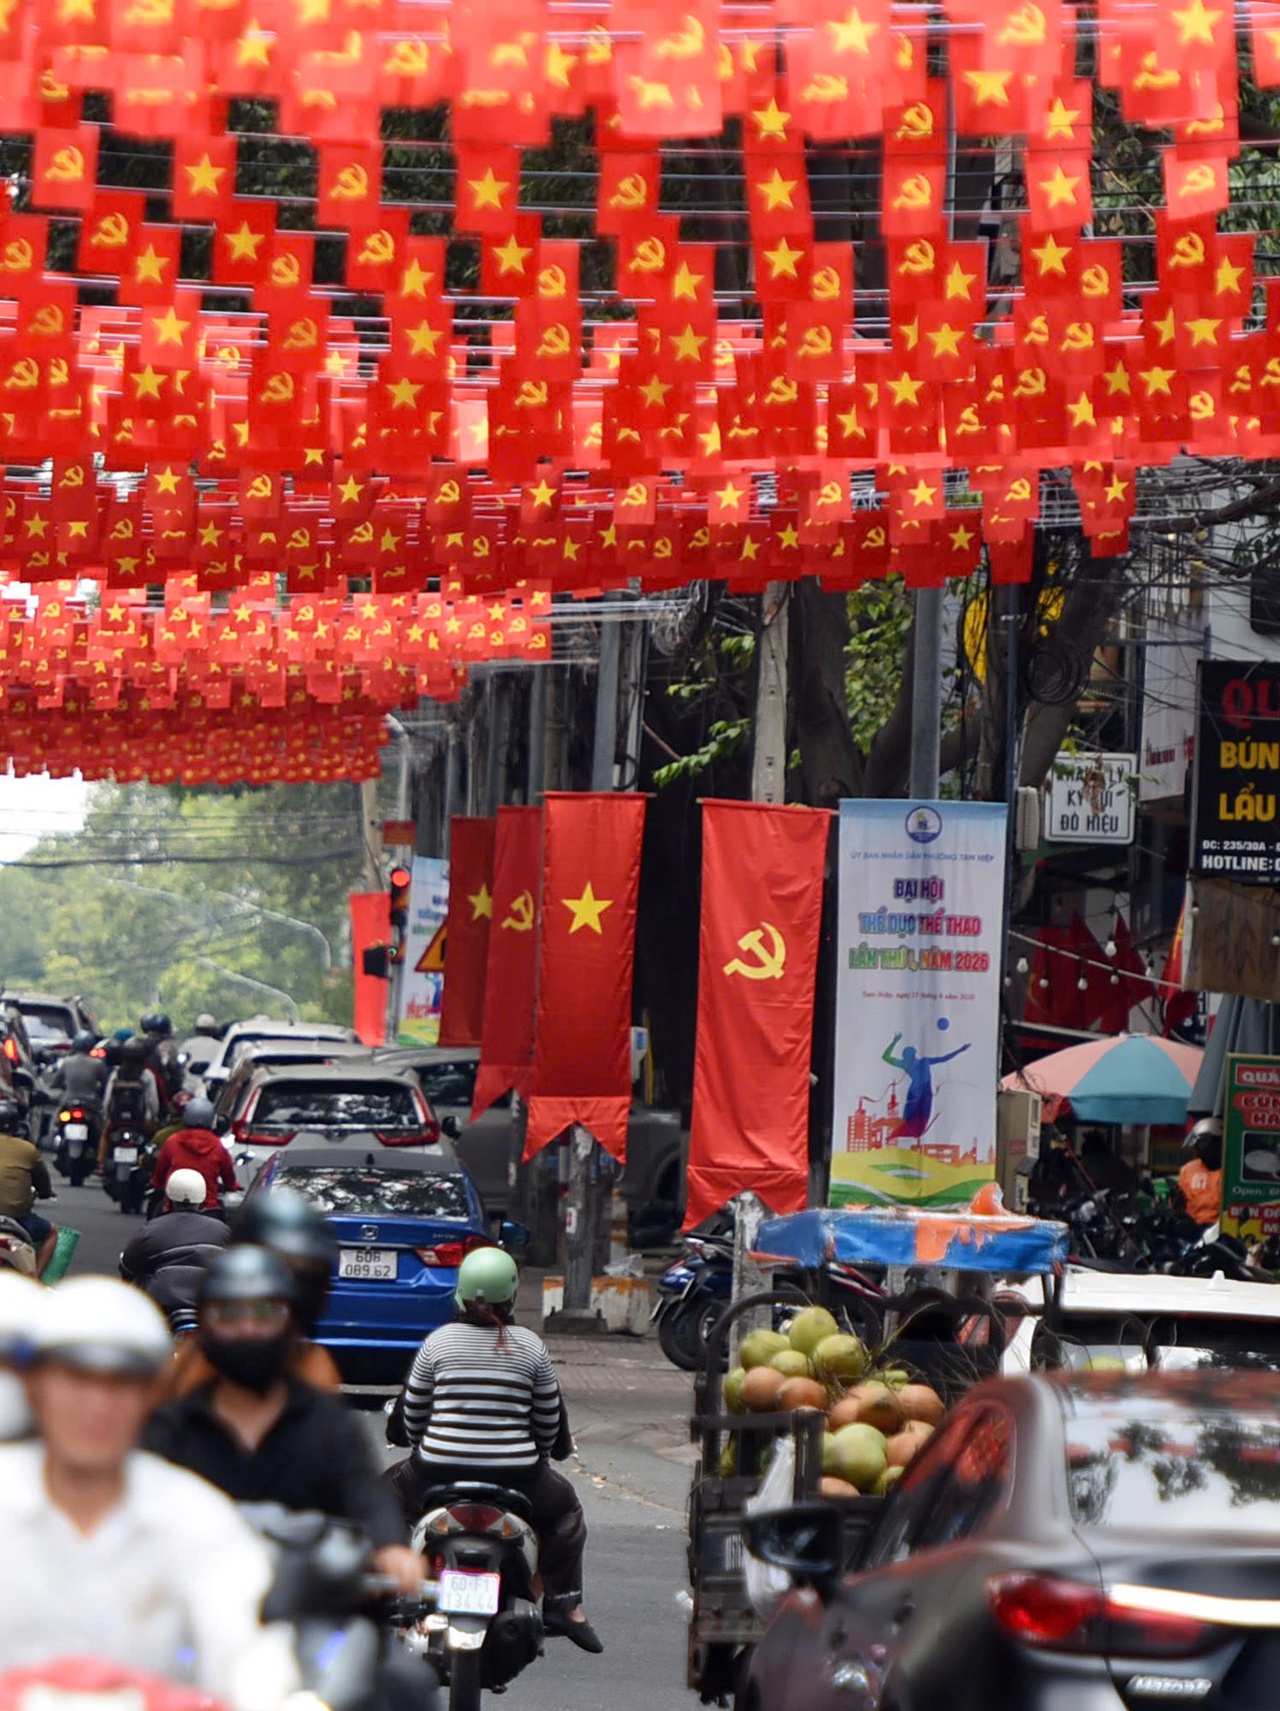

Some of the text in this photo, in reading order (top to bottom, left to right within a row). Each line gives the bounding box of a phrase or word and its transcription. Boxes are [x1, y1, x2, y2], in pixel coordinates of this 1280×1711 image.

[1221, 736, 1280, 770] BÚN
[1220, 782, 1276, 821] LẨU
[1086, 813, 1119, 834] HIỆU
[920, 875, 945, 903] HỘI
[946, 914, 982, 937] THAO
[955, 951, 990, 972] 2026
